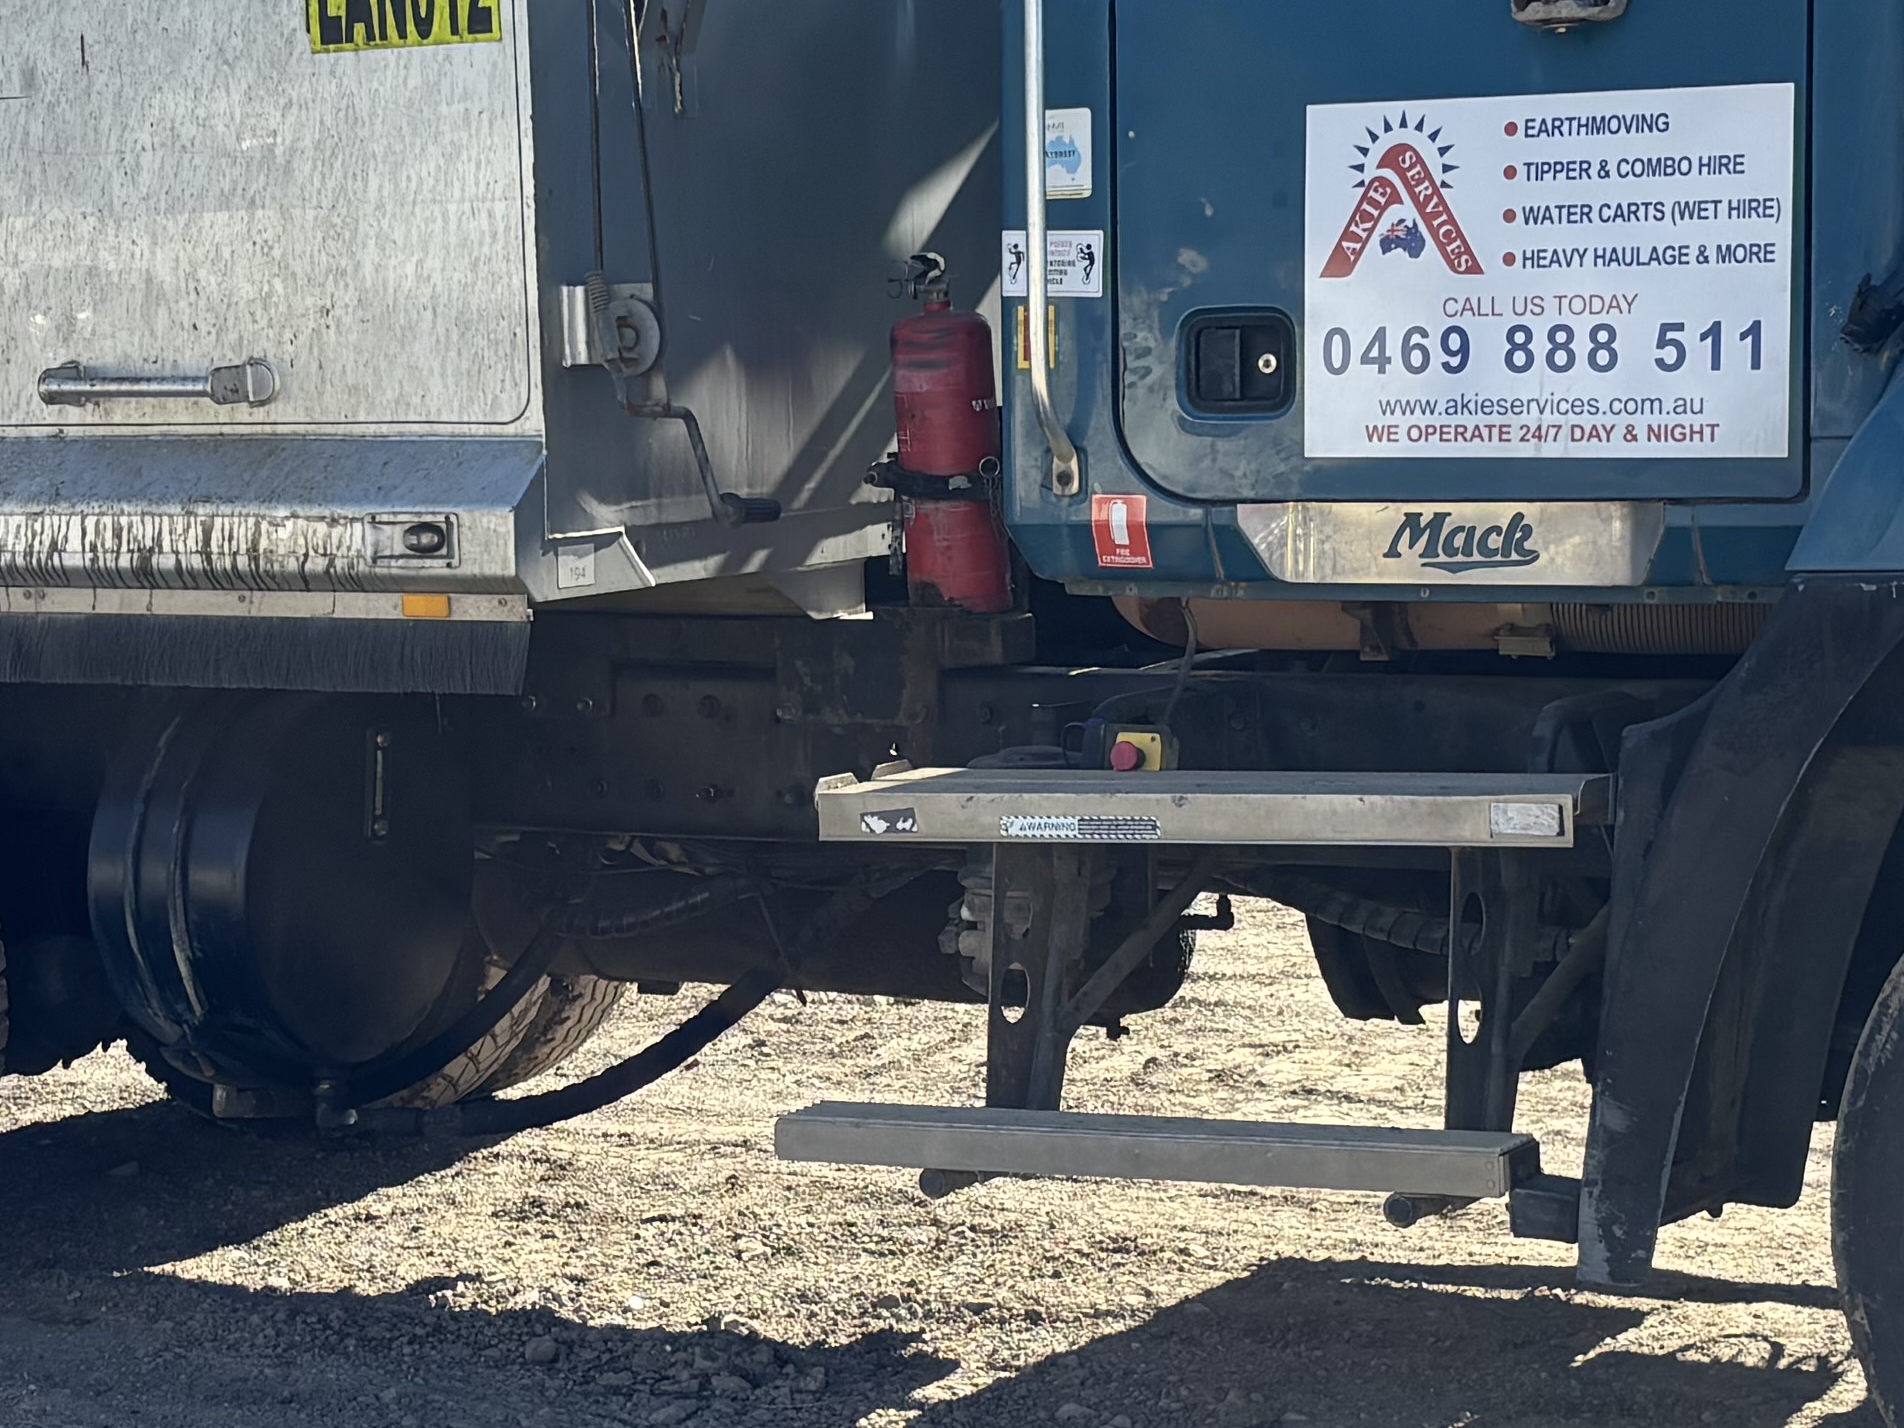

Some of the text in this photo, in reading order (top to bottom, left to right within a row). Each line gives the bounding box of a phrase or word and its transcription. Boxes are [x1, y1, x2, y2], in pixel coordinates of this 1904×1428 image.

[1523, 113, 1670, 138] EARTHMOVING
[1523, 154, 1746, 182] TIPPER & COMBO HIRE
[1341, 181, 1392, 262] AKIE
[1398, 151, 1472, 272] SERVICES
[1522, 197, 1782, 226] WATER CARTS (WET HIRE)
[1522, 243, 1776, 269] HEAVY HAULAGE & MORE
[1442, 293, 1638, 318] CALL US TODAY
[1323, 320, 1762, 375] 0469 888 511
[1379, 392, 1704, 416] www.akieservices.com.au
[1365, 423, 1720, 443] WE OPERATE 24/7 DAY & NIGHT
[1382, 512, 1540, 562] Mack
